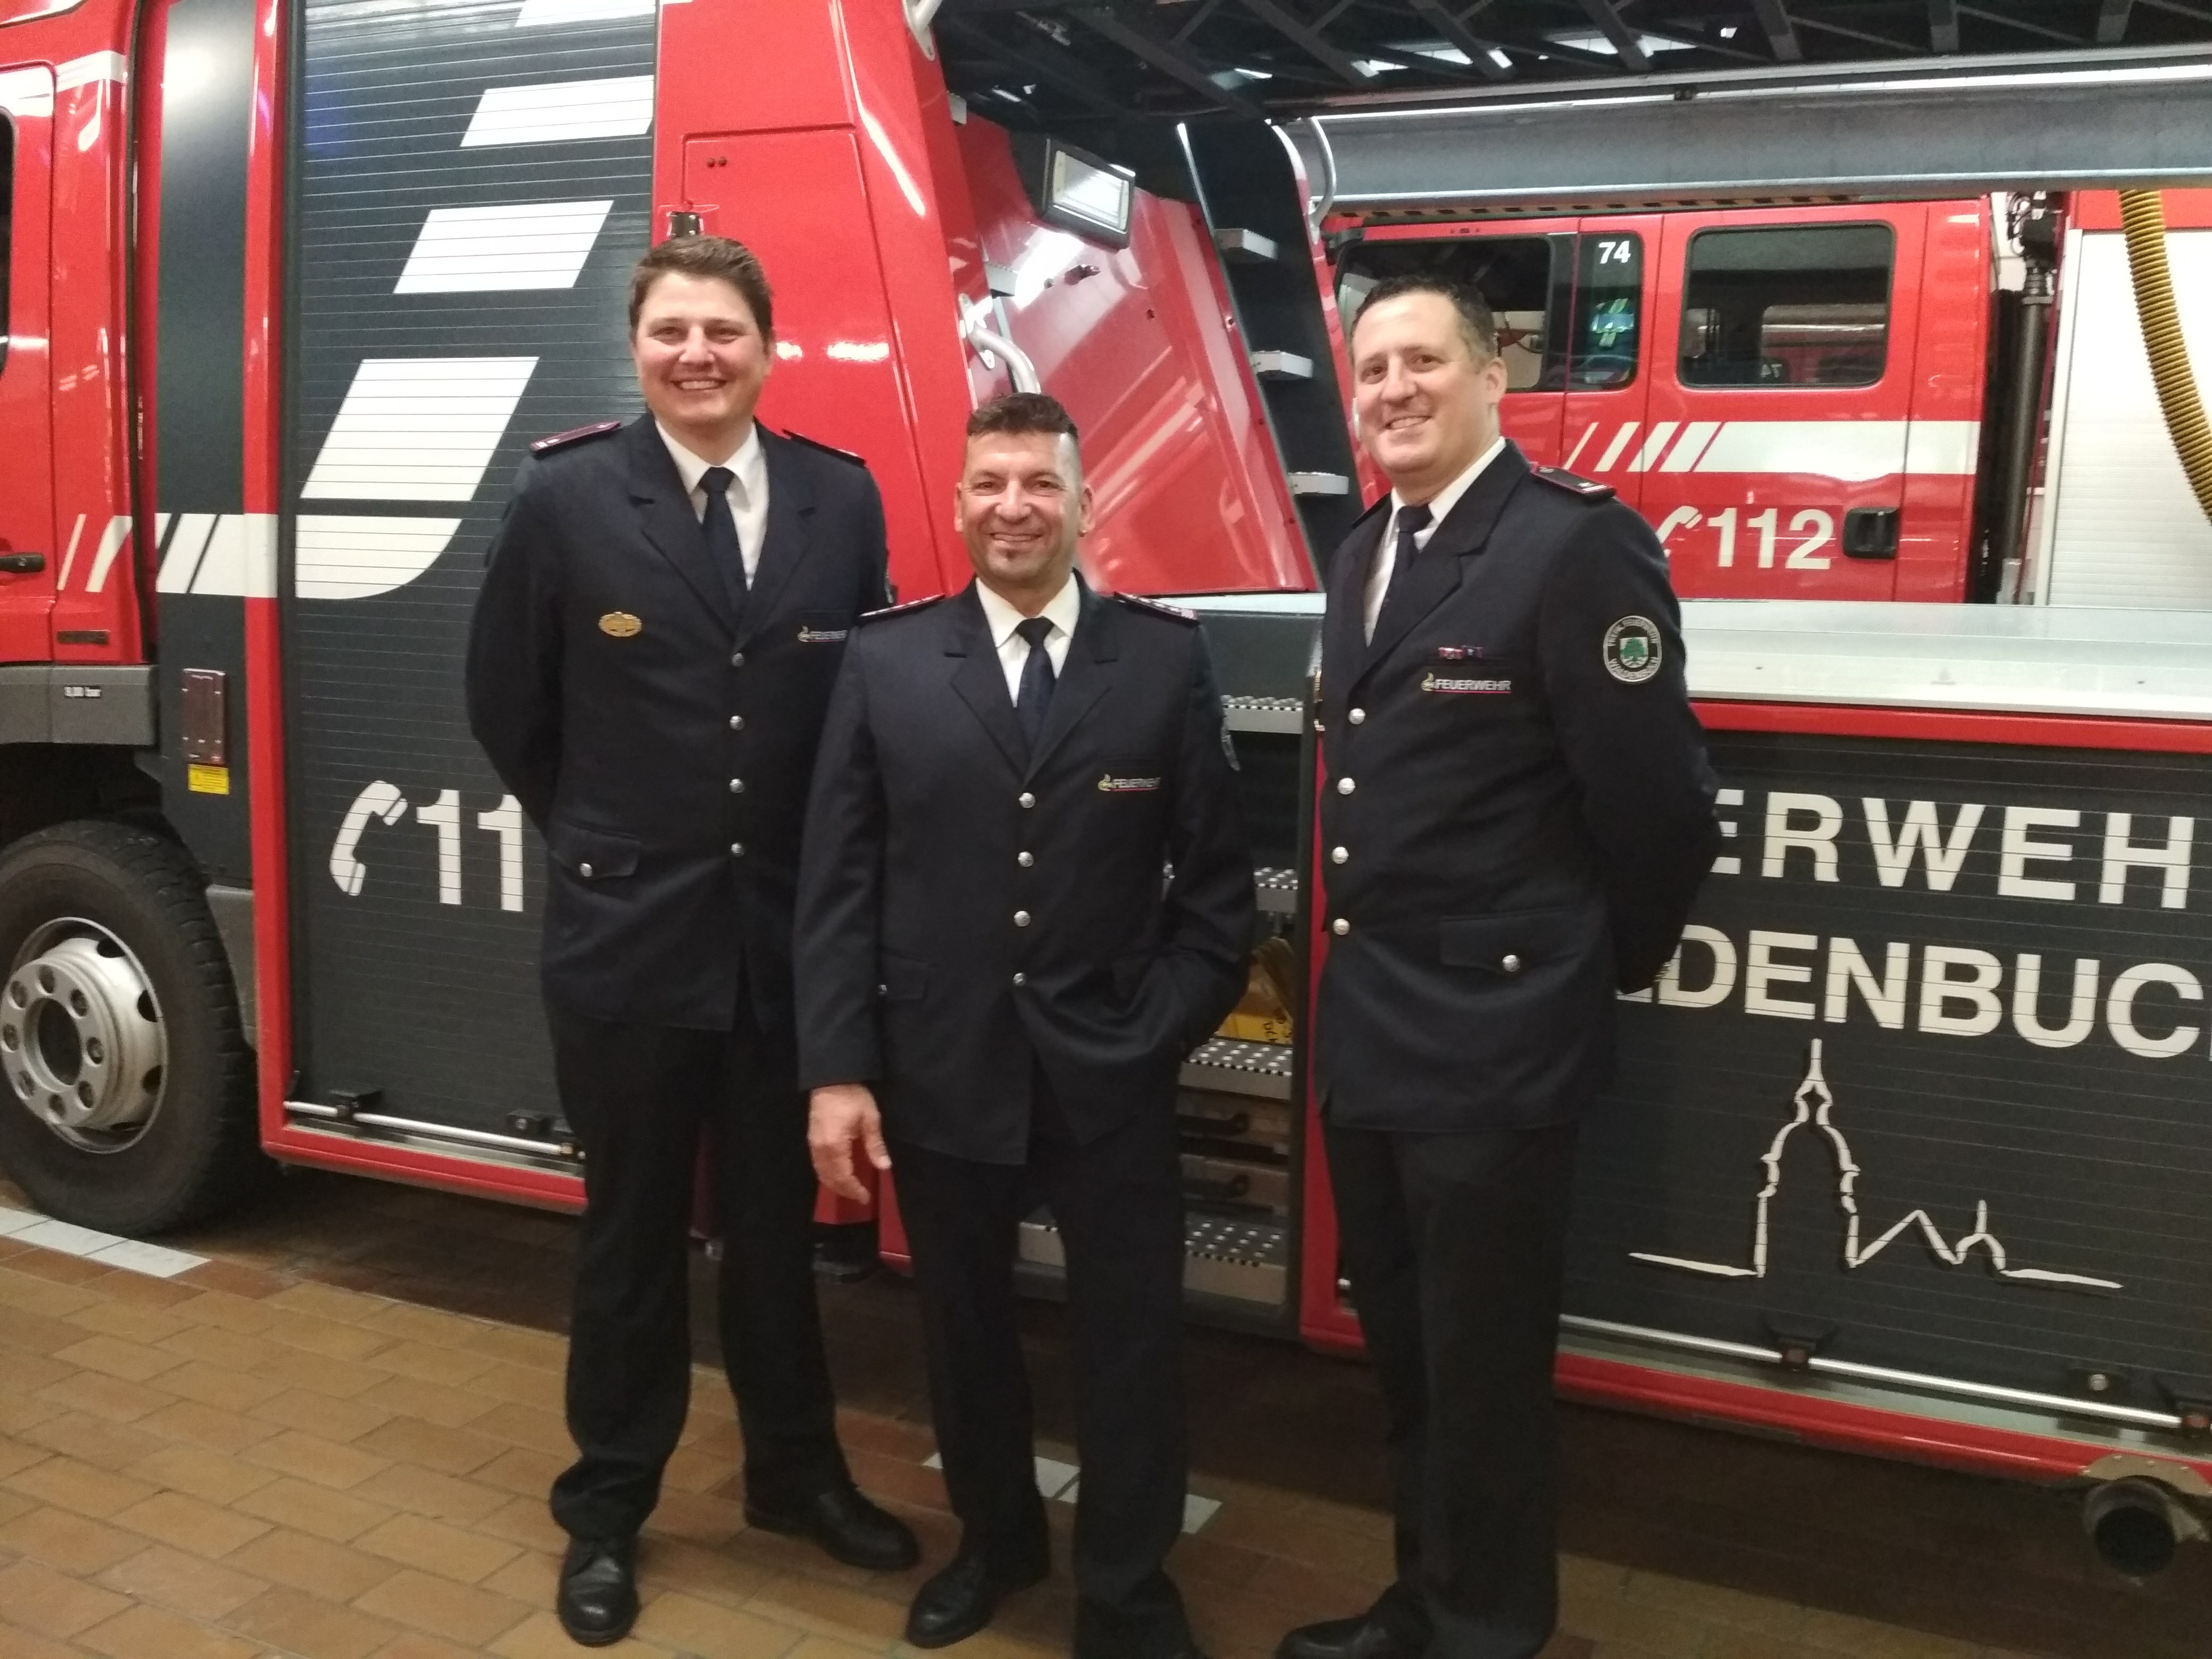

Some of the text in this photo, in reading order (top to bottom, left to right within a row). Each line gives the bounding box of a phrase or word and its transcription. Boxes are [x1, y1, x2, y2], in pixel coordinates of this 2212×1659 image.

[1598, 240, 1631, 264] 74
[1707, 507, 1834, 569] 112
[1435, 679, 1511, 690] FEUERWEHR
[1615, 924, 2212, 1062] DENBUC
